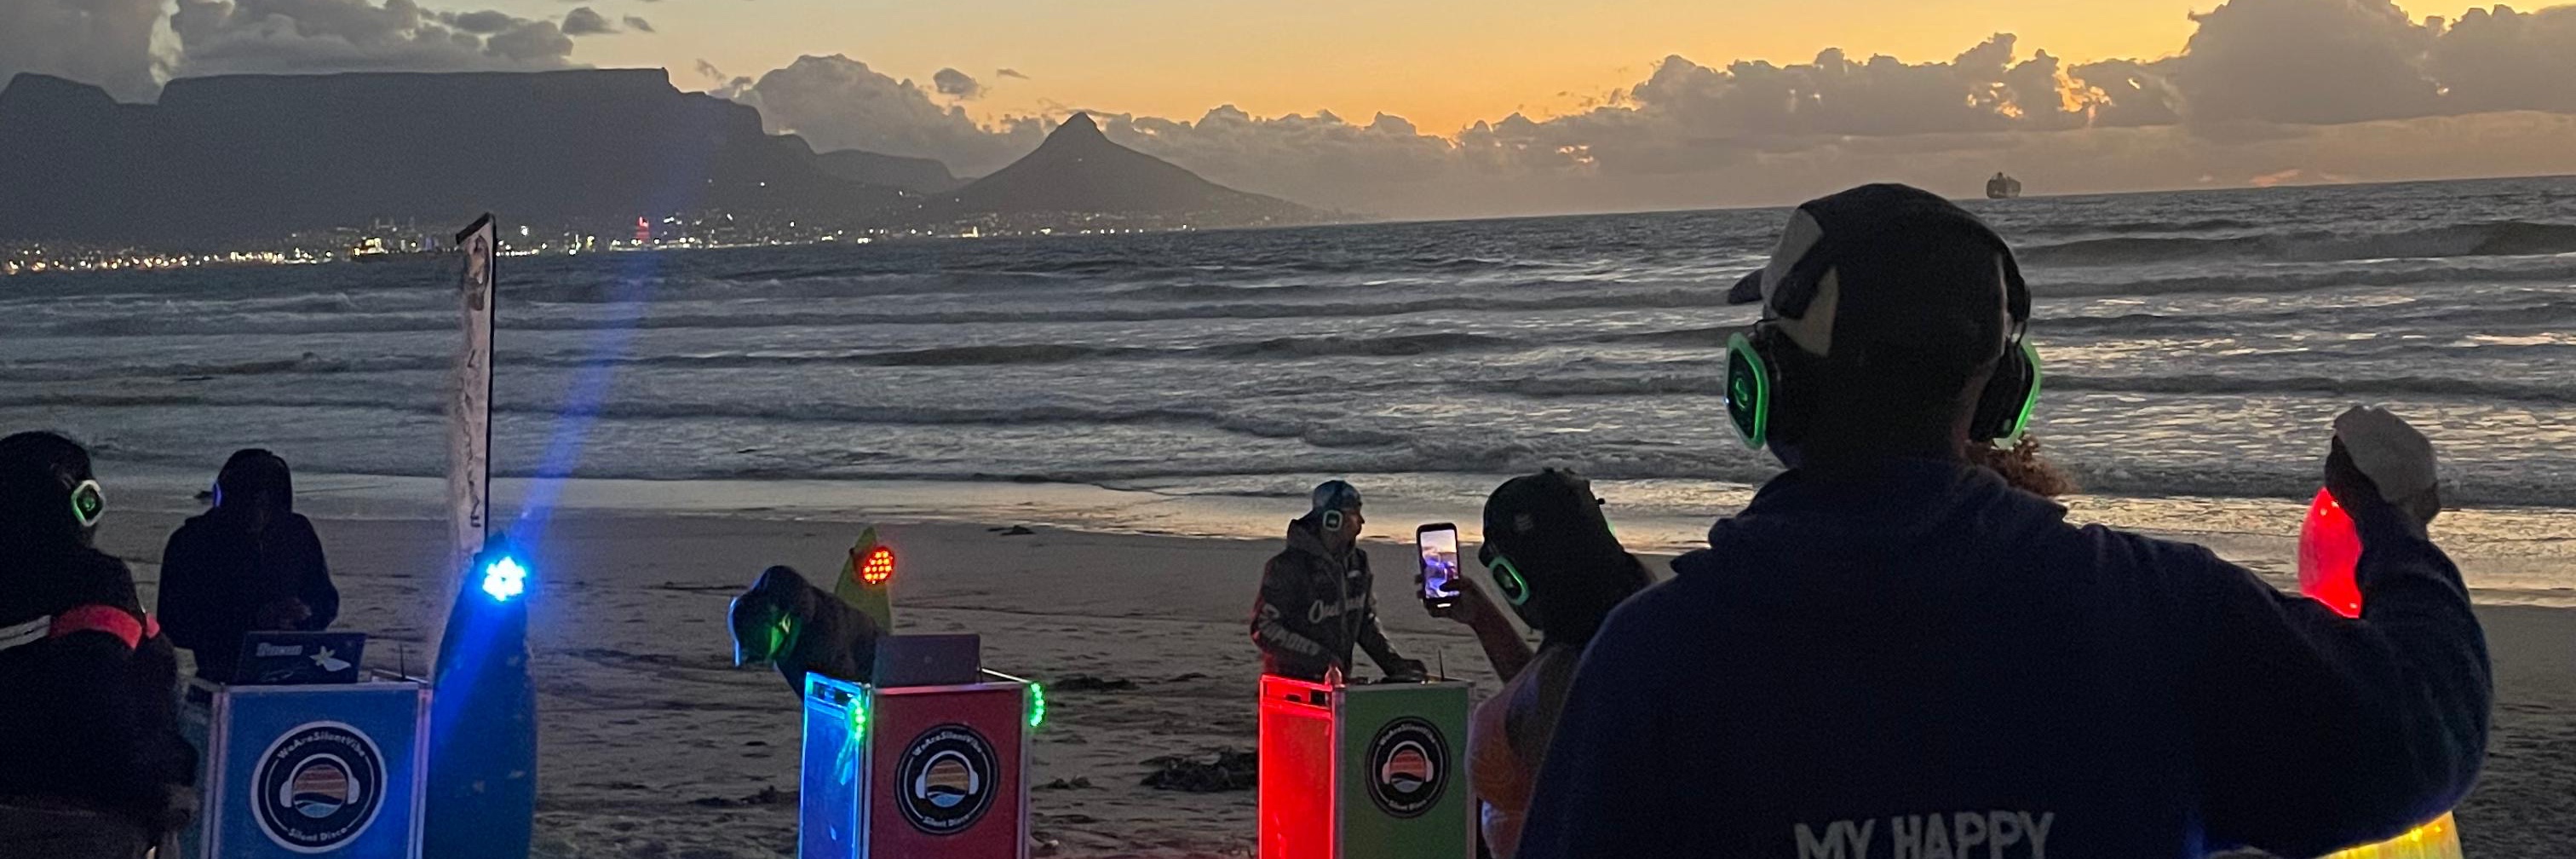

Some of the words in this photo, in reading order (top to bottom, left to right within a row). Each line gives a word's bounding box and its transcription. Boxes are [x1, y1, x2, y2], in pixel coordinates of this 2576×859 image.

[277, 731, 366, 759] WeAreSilentVibe
[288, 827, 318, 842] Silent
[319, 827, 348, 841] Disco
[1794, 819, 1877, 859] MY
[1891, 810, 2055, 859] HAPPY
